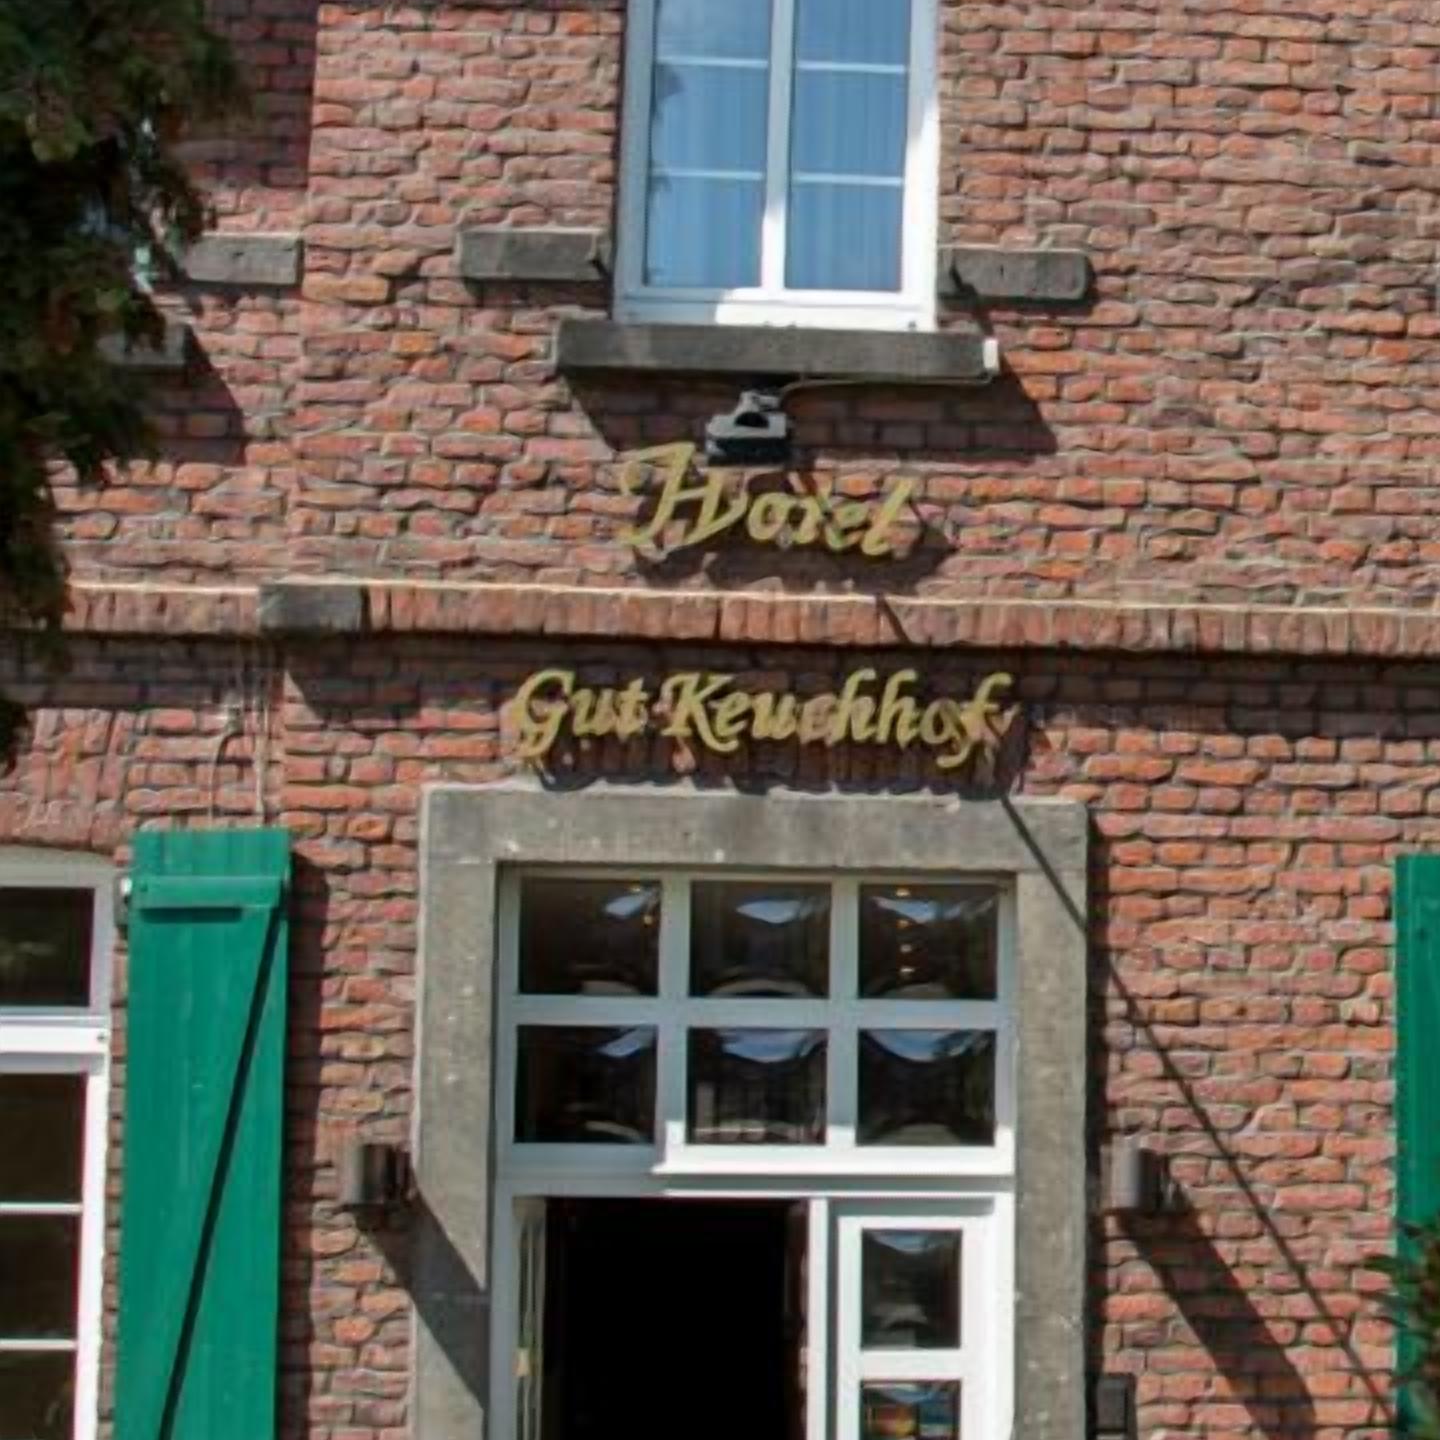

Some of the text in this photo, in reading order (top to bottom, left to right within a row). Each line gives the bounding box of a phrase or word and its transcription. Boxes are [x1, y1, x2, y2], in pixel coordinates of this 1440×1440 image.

[618, 441, 913, 556] Hotel
[512, 668, 1018, 768] Gut Keuchhof
